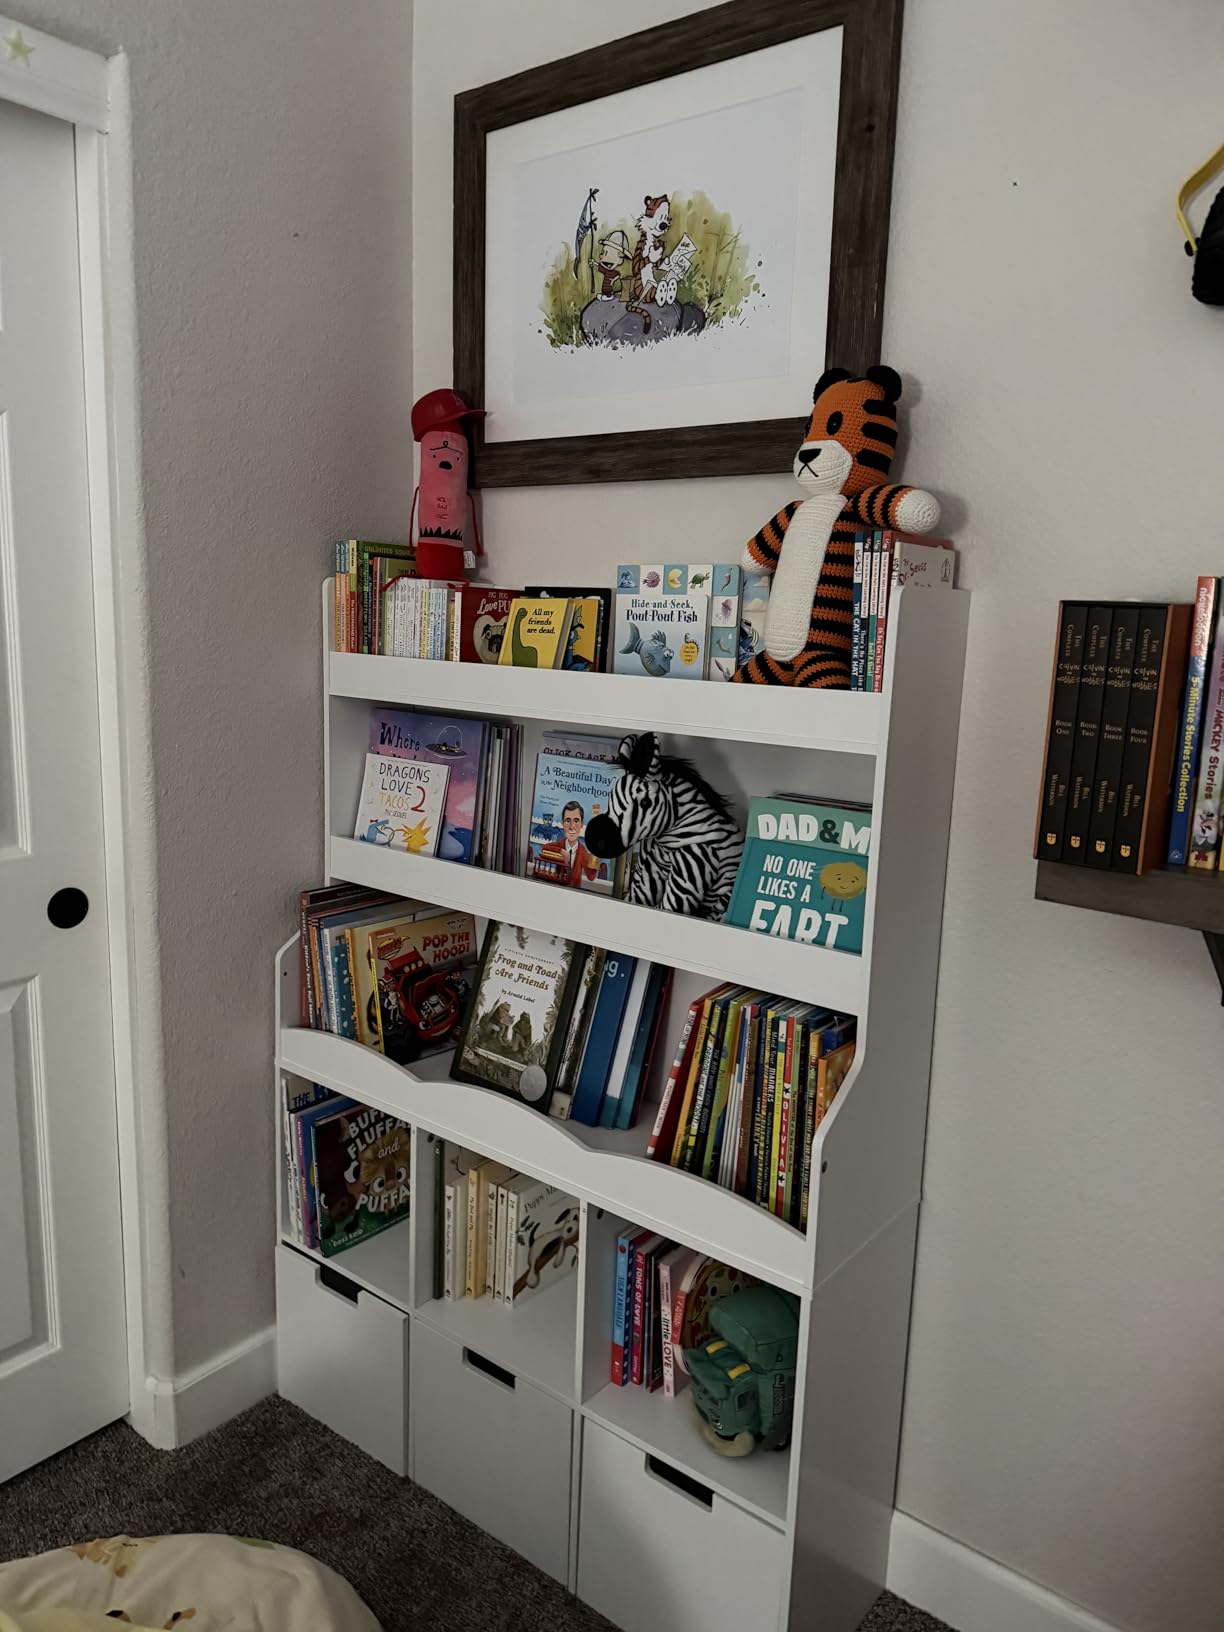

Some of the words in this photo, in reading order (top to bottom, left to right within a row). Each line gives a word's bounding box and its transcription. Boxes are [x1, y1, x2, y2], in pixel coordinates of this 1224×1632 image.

[436, 496, 449, 520] RED
[477, 598, 498, 614] Love
[532, 608, 542, 616] All
[543, 610, 554, 618] my
[625, 609, 674, 622] Pout-Pout
[678, 610, 698, 623] Fish
[1194, 587, 1209, 646] nickelodeon
[853, 635, 859, 643] IN
[1187, 676, 1201, 724] 5-Minute
[380, 722, 420, 751] Where
[1080, 721, 1097, 729] BOOK
[1104, 732, 1122, 741] THREE
[1105, 724, 1123, 732] BOOK
[1210, 709, 1224, 752] MICKEY
[1130, 736, 1147, 744] FOUR
[1182, 725, 1196, 761] Stories
[379, 762, 431, 783] DRAGONS
[540, 766, 550, 776] A
[552, 766, 593, 784] Beautiful
[595, 774, 617, 787] Day
[1204, 756, 1219, 800] Stories
[381, 778, 414, 796] LOVE
[1177, 762, 1191, 812] Collection
[379, 791, 411, 811] TACOS
[410, 785, 426, 813] 2
[763, 854, 784, 874] NO
[786, 859, 816, 880] ONE
[757, 876, 797, 899] LIKES
[800, 884, 812, 903] A
[749, 899, 849, 949] FART
[422, 934, 448, 952] POP
[450, 931, 470, 944] THE
[494, 953, 517, 968] Frog
[517, 962, 534, 972] and
[535, 965, 558, 979] Toad
[495, 968, 513, 979] Are
[514, 973, 549, 991] Friends
[349, 1108, 385, 1139] BUF
[779, 1100, 790, 1168] OLIVIA
[346, 1116, 411, 1160] FLUFFA
[378, 1136, 401, 1158] and
[634, 1266, 643, 1289] TONS
[634, 1291, 642, 1302] OF
[633, 1304, 641, 1326] LOVE
[661, 1316, 671, 1340] little
[662, 1340, 672, 1368] LOVE
